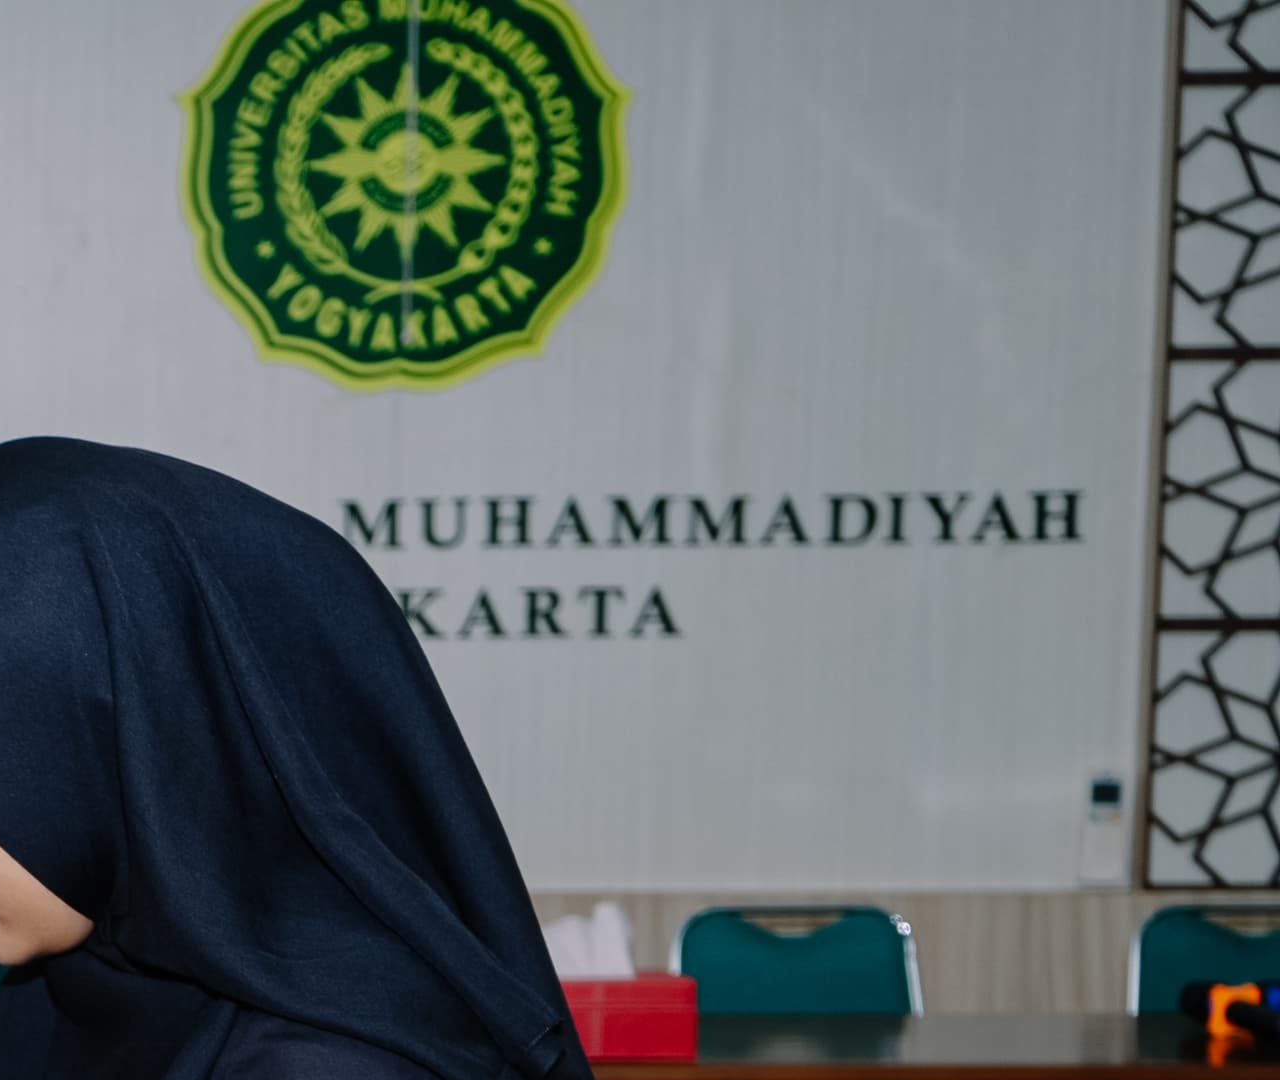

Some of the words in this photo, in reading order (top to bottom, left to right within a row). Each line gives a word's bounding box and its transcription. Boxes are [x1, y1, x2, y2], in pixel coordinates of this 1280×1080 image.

[228, 0, 370, 220] UNIVERSITAS
[378, 0, 582, 217] MUHAMMADIYAH
[266, 264, 537, 353] YOGYAKARTA
[342, 490, 1083, 549] MUHAMMADIYAH
